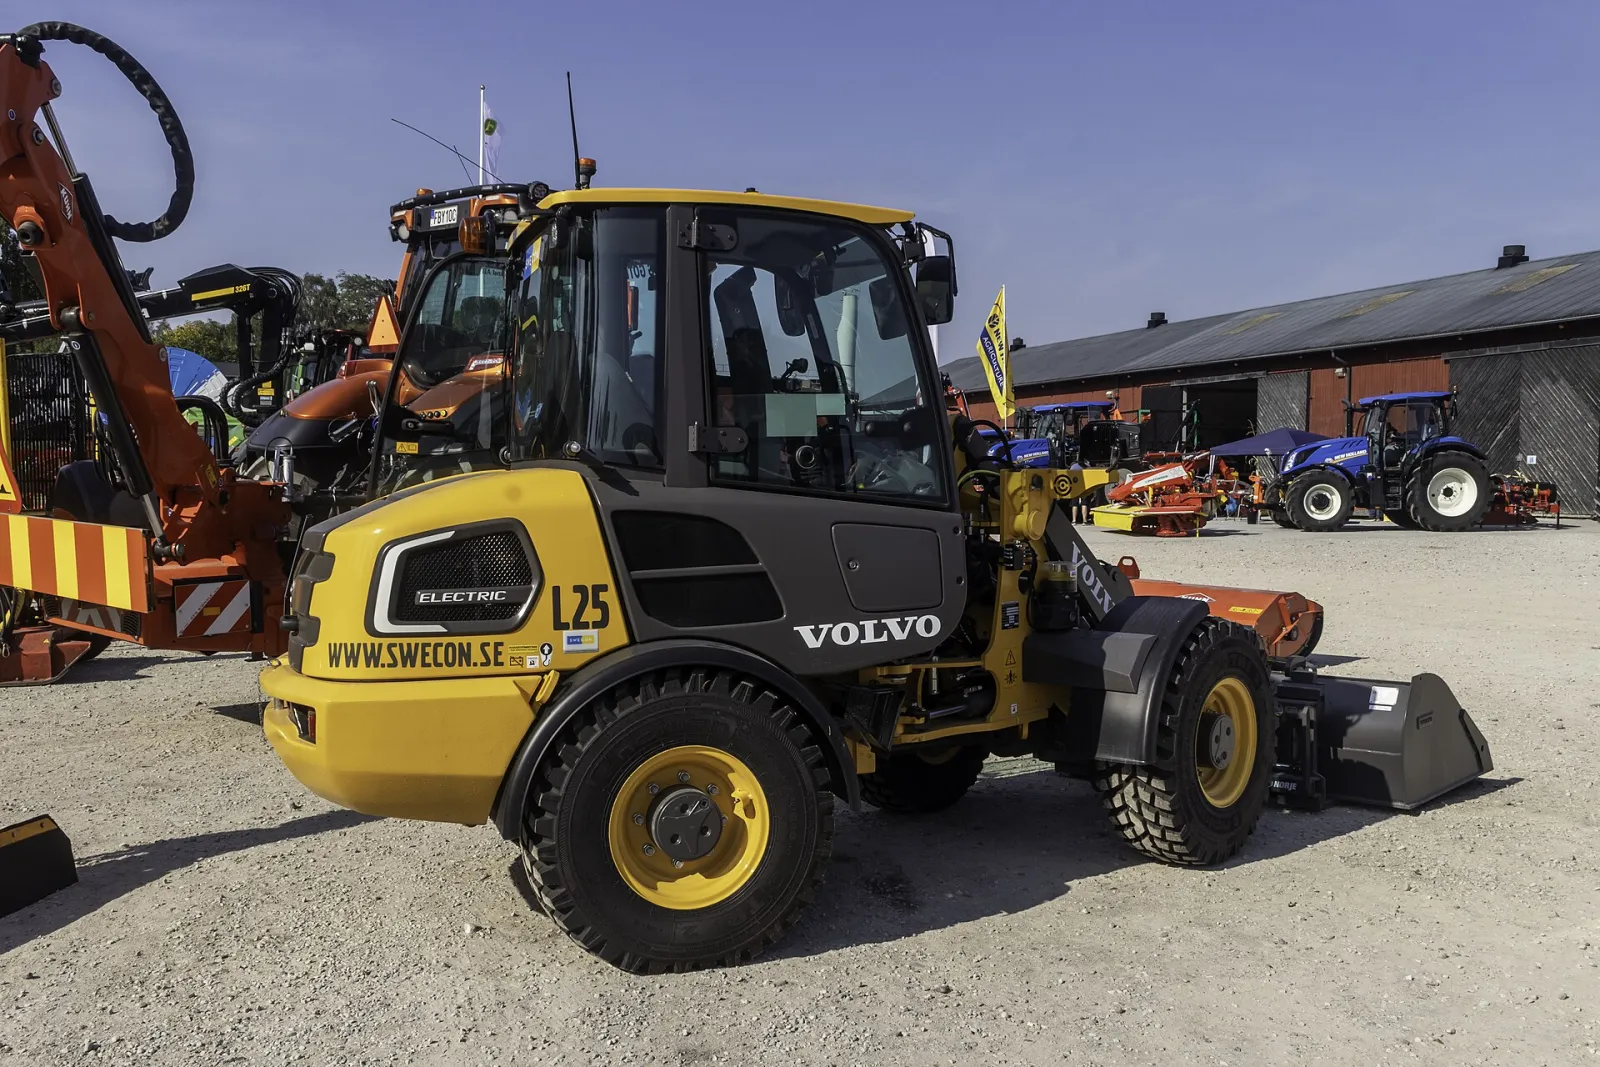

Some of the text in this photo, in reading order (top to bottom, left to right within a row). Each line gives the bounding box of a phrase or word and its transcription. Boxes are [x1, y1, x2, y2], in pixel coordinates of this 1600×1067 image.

[235, 284, 250, 293] 326T
[982, 337, 1004, 387] AGRICULTURE
[1072, 541, 1115, 614] VOLV
[419, 590, 507, 603] ELECTRIC
[552, 584, 609, 630] L25
[793, 614, 941, 649] VOLVO
[328, 642, 504, 668] WWW.SWECON.SE
[1273, 780, 1298, 791] NORJE
